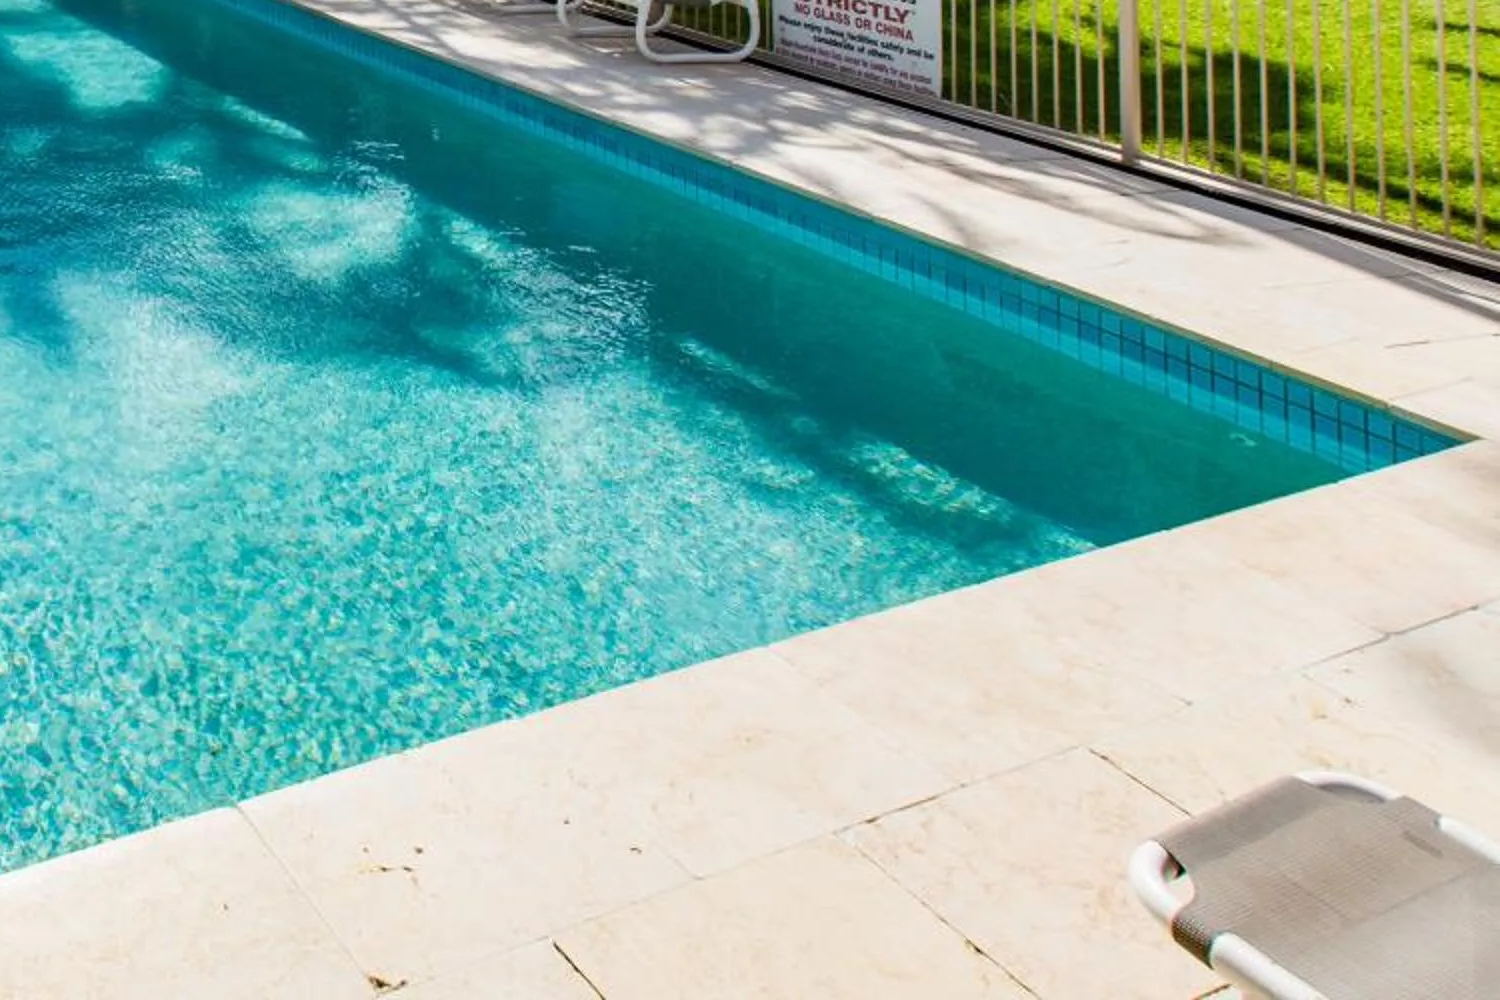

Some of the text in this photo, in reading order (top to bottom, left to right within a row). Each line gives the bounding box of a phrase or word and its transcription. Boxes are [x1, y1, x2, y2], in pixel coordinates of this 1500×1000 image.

[794, 2, 913, 41] NO GLASS OR CHINA
